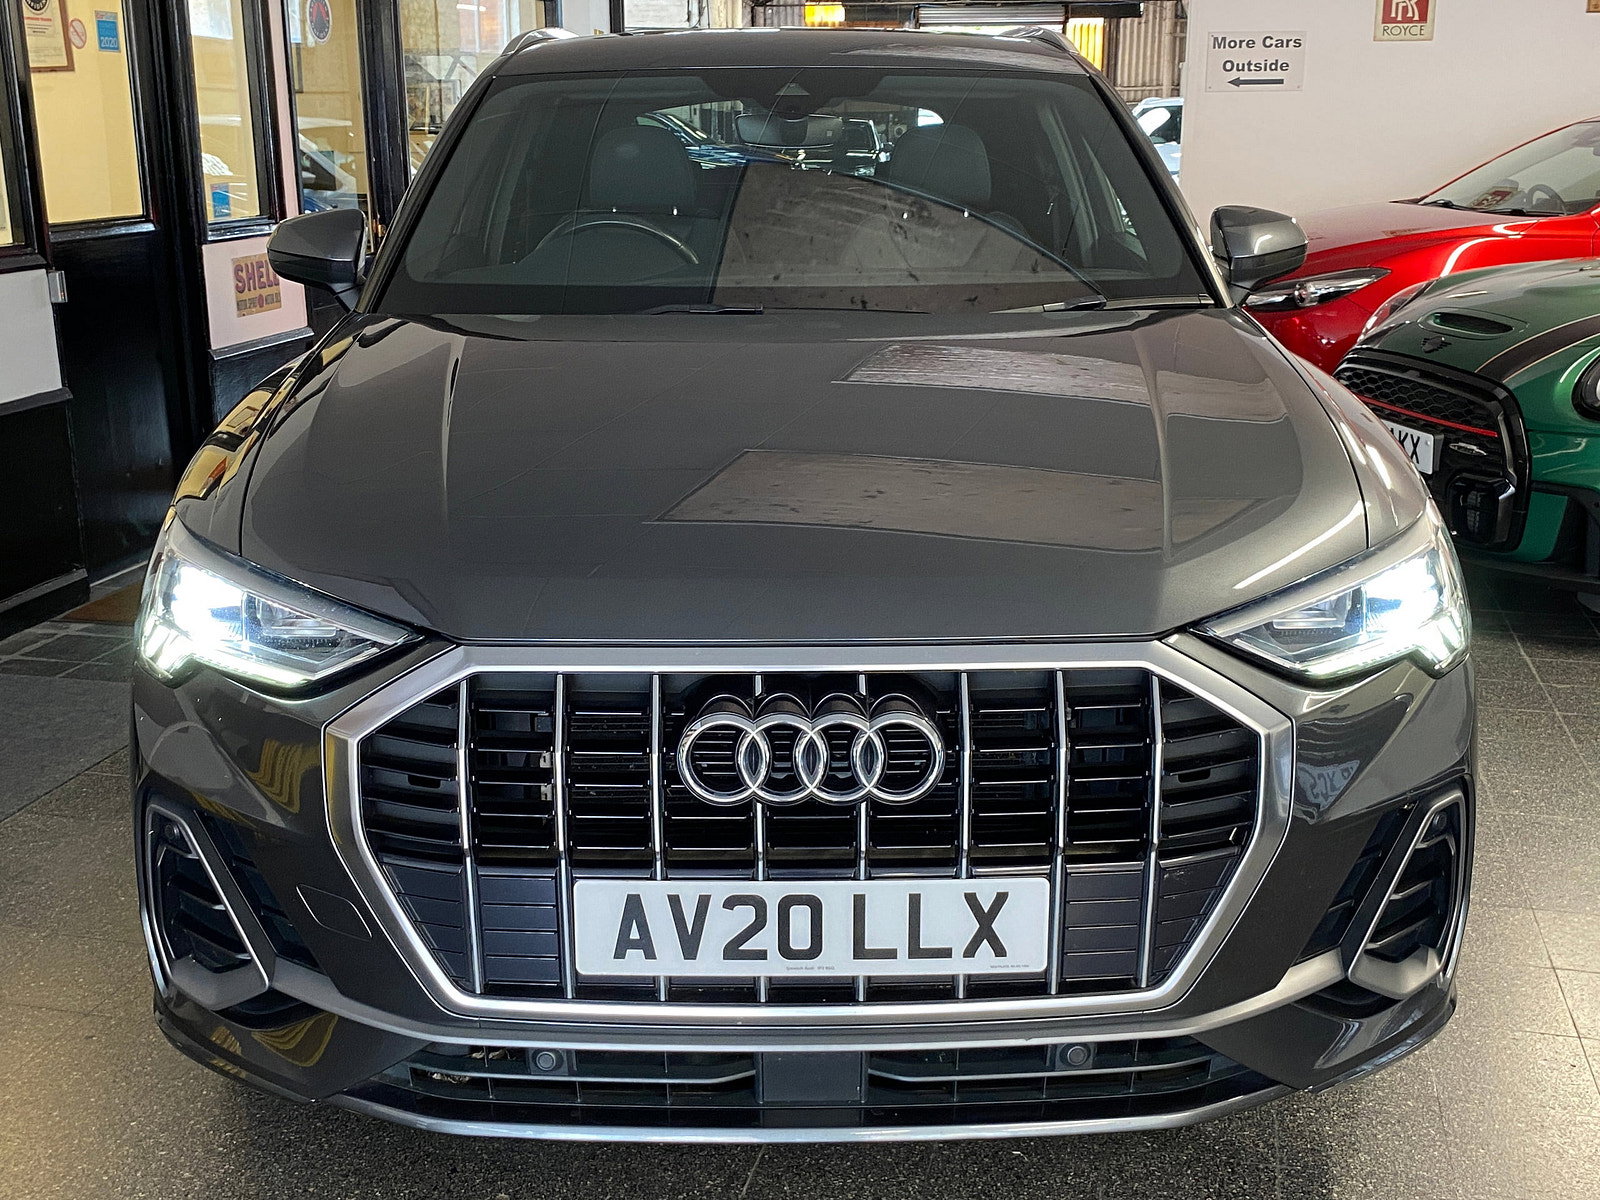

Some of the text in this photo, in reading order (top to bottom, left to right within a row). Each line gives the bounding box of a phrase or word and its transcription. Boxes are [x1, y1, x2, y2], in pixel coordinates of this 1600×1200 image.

[1382, 25, 1425, 36] ROYCE
[100, 36, 118, 48] 2020
[1212, 35, 1303, 49] More Cars
[1222, 59, 1290, 72] Outside
[1390, 427, 1421, 465] KX
[612, 891, 1010, 962] AV20 LLX
